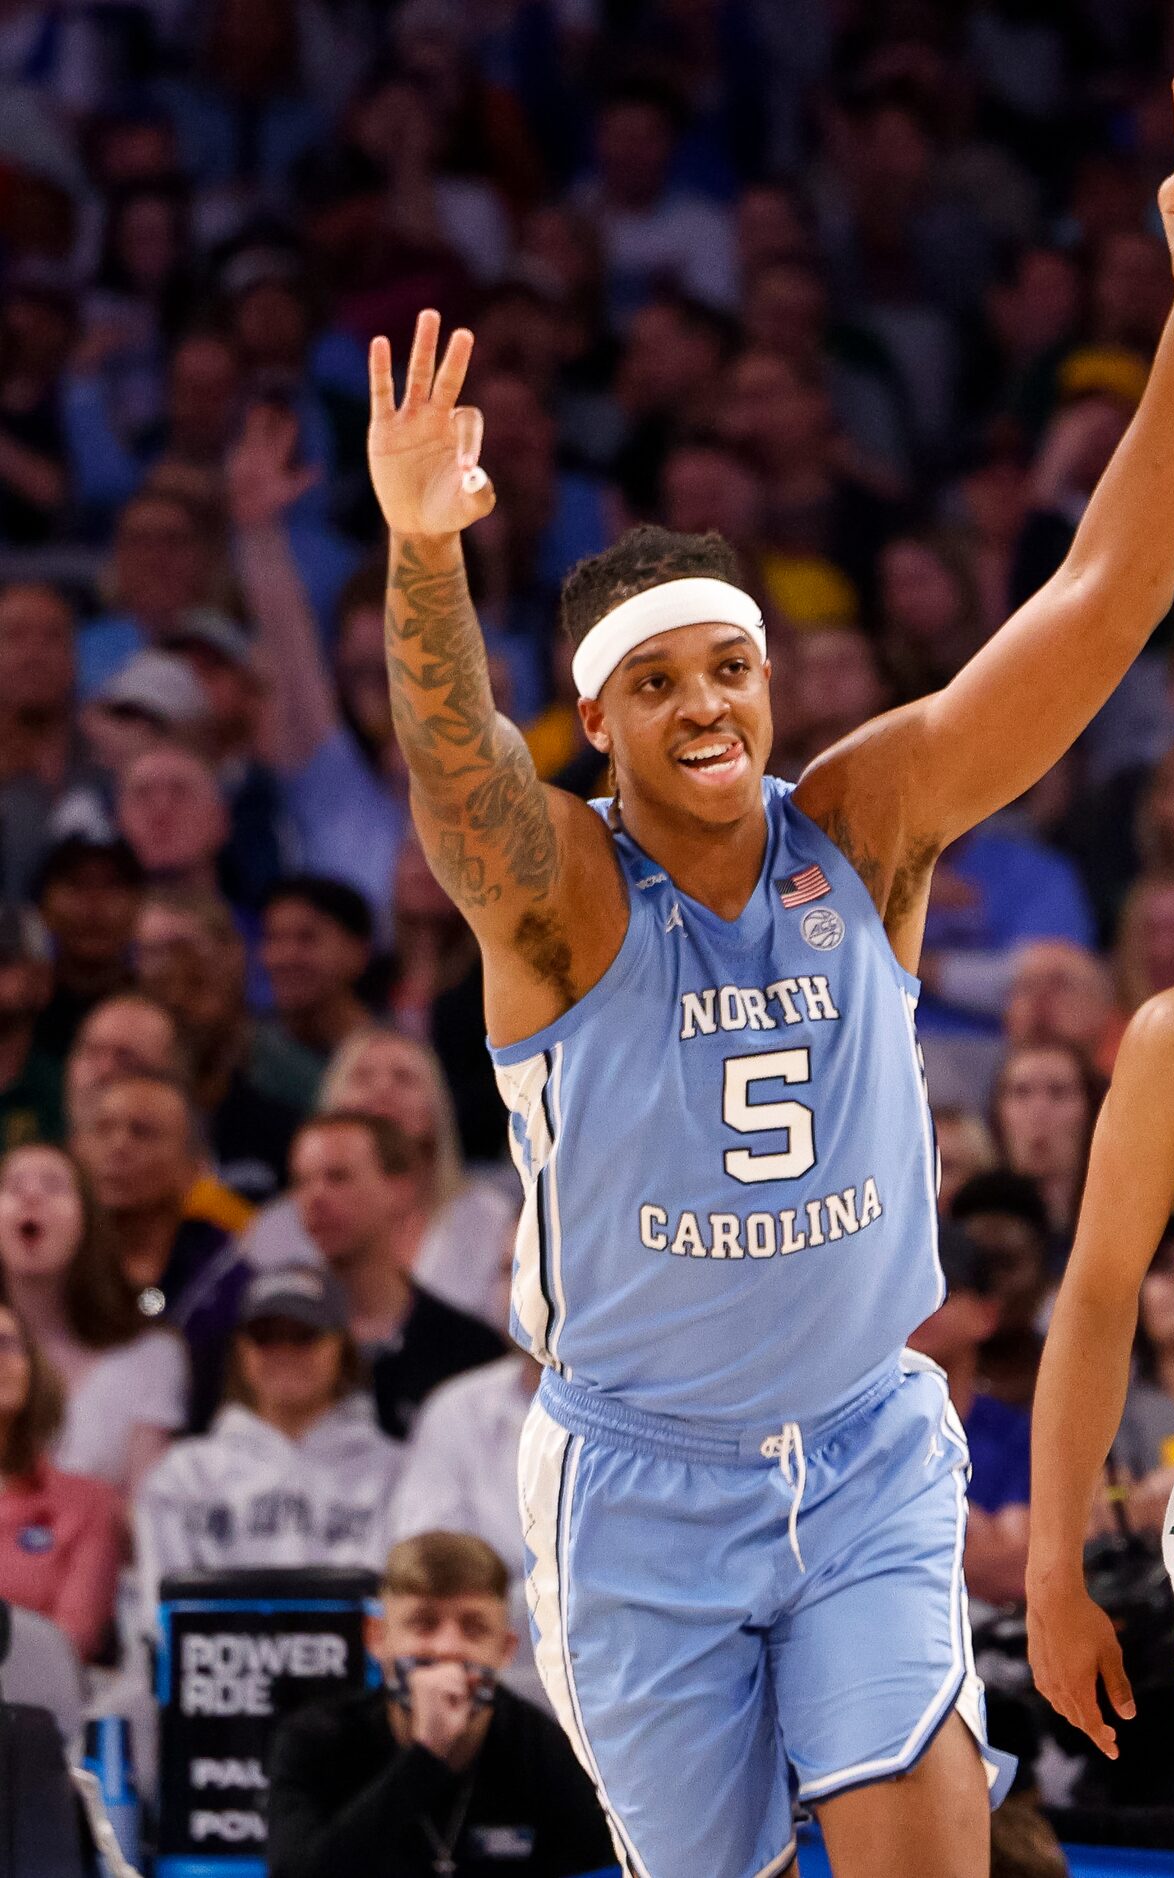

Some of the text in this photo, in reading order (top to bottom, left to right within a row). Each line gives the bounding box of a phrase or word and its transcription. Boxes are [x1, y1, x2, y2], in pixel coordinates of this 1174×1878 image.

[680, 975, 839, 1041] NORTH
[722, 1047, 817, 1184] 5
[639, 1176, 883, 1260] CAROLINA
[181, 1632, 349, 1678] POWER
